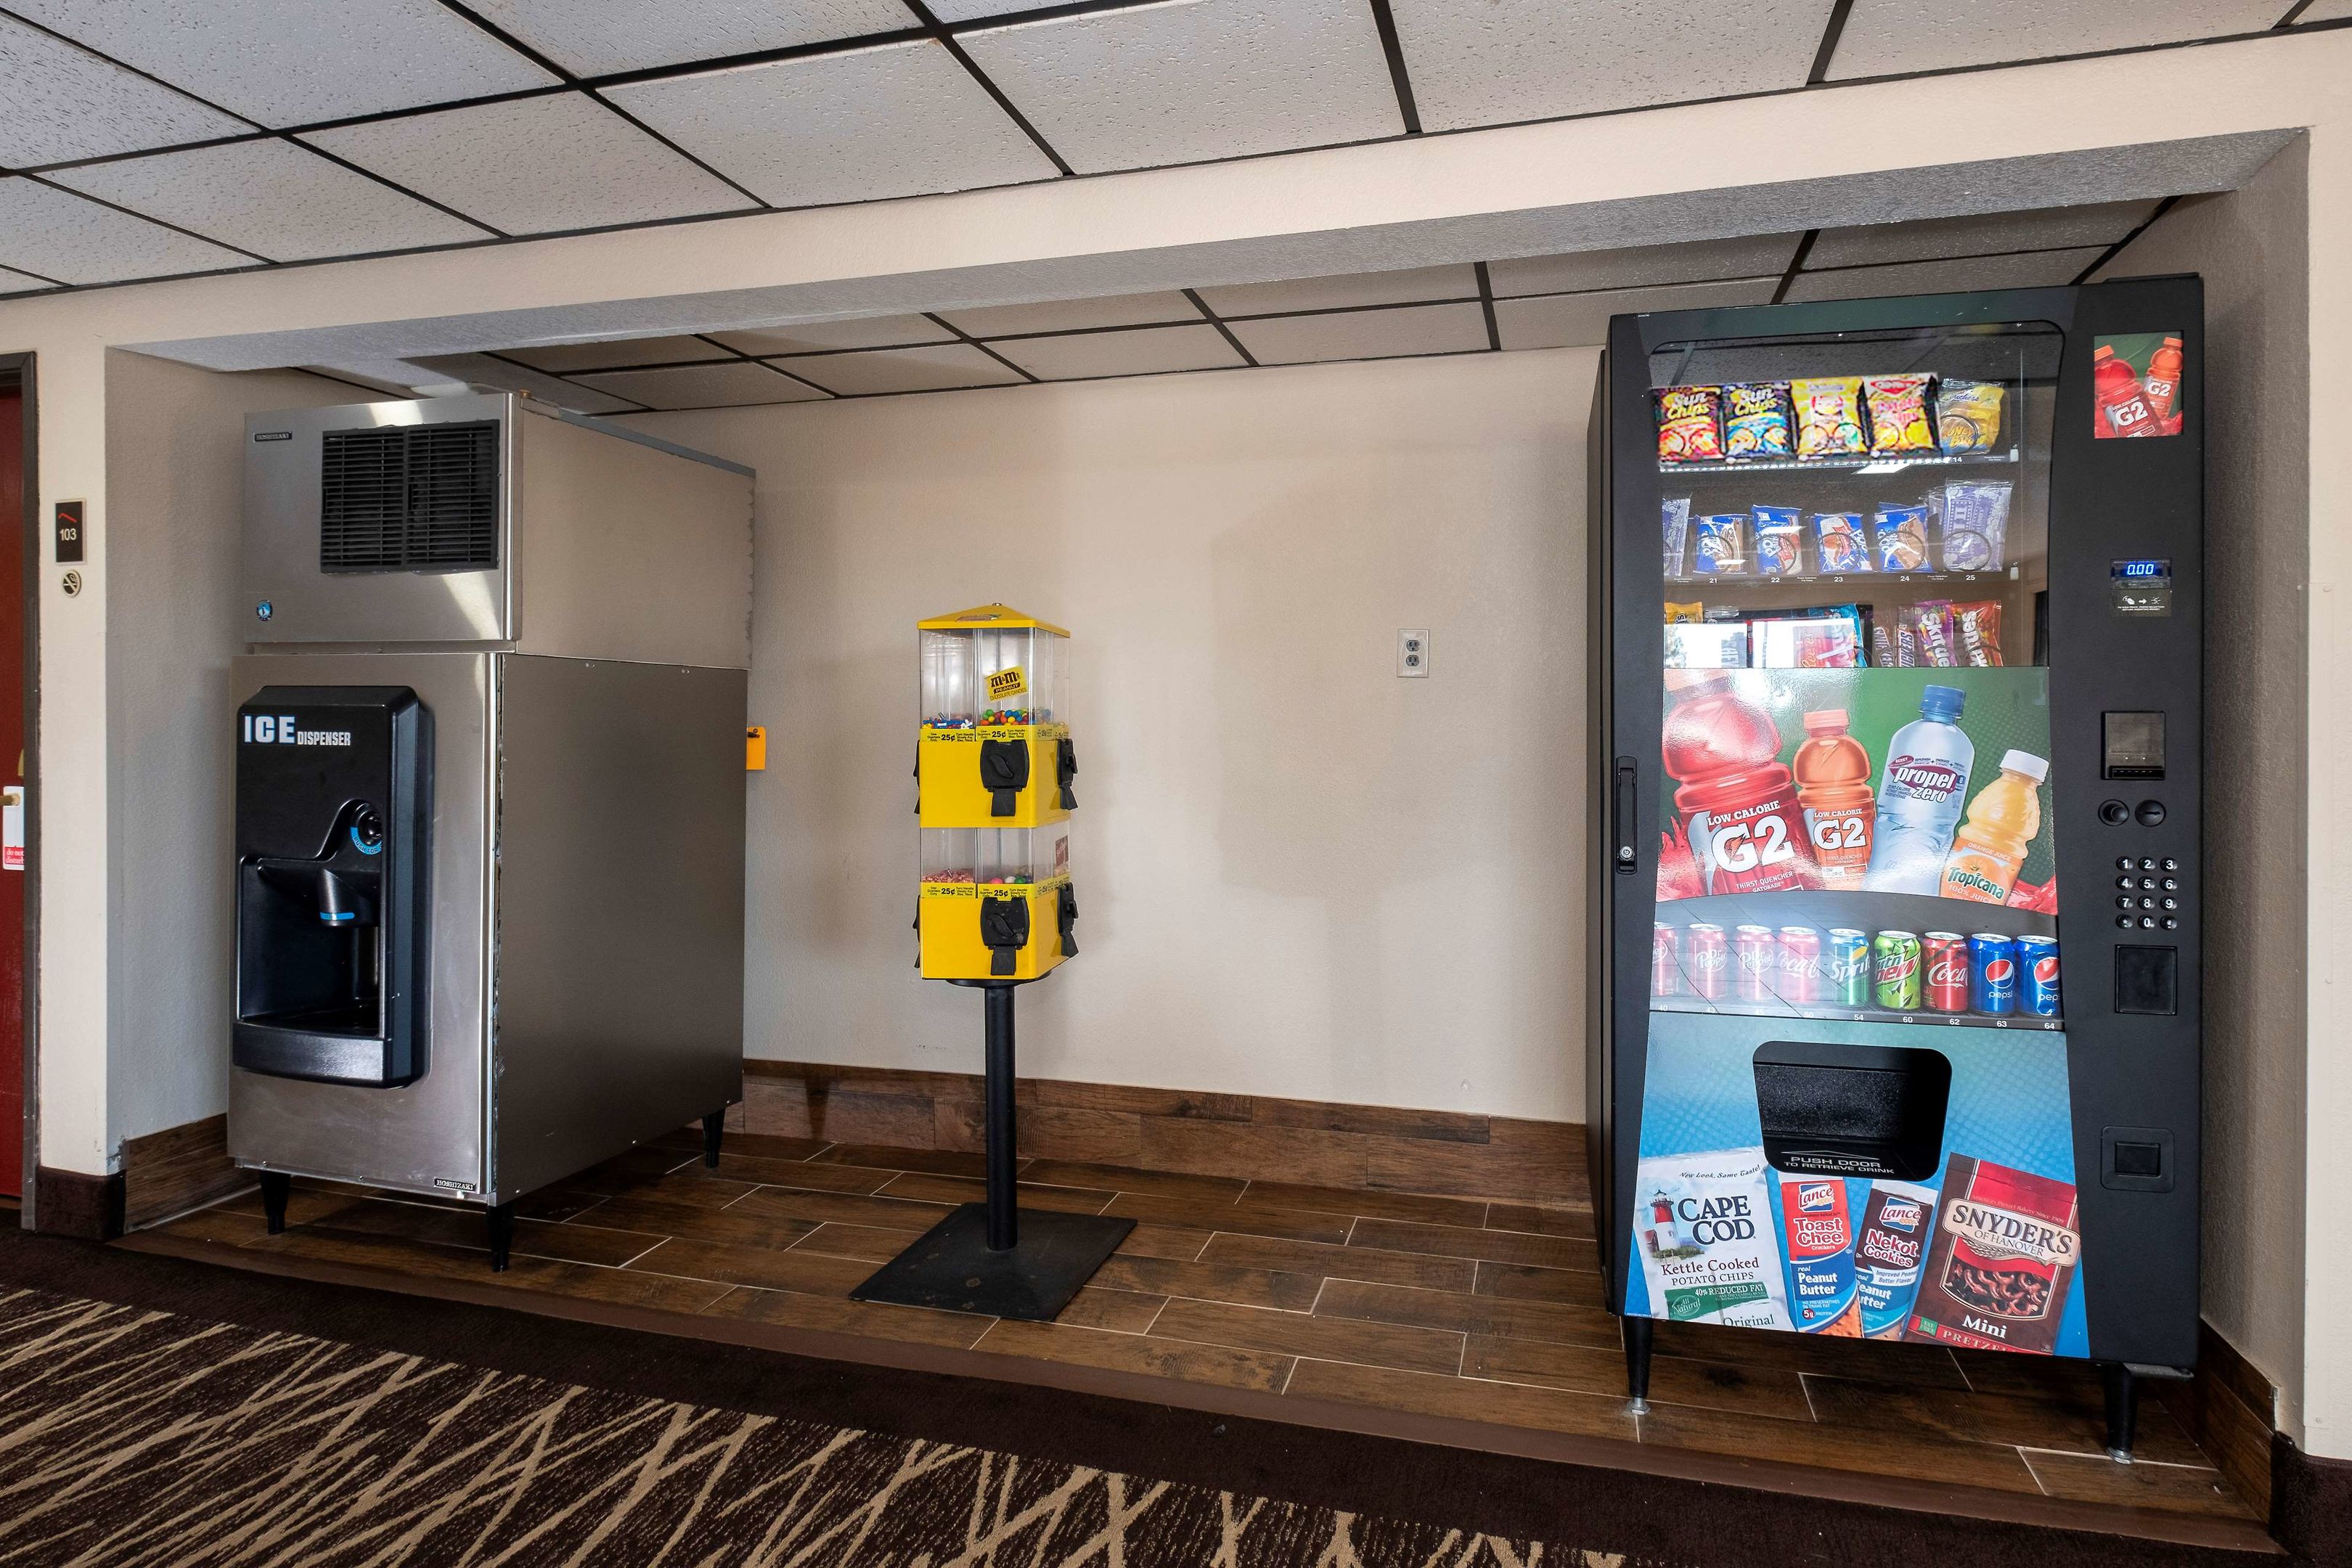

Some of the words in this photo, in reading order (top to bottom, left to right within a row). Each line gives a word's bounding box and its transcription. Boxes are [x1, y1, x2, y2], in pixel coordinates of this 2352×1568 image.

[2149, 382, 2171, 396] G2
[2115, 401, 2148, 426] G2
[60, 528, 77, 541] 103
[995, 684, 1018, 693] PEANUT
[245, 716, 295, 743] ICE
[297, 731, 351, 746] DISPENSER
[1893, 767, 1956, 789] propel
[1911, 786, 1948, 803] zero
[1707, 813, 1731, 826] LOW
[1734, 801, 1781, 820] CALORIE
[1813, 817, 1866, 850] G2
[1712, 814, 1795, 873] G2
[1968, 842, 1994, 854] ORANGE
[1994, 852, 2012, 862] JUICE
[2123, 859, 2128, 869] 1
[2144, 859, 2151, 869] 2
[2166, 859, 2173, 870] 3
[1736, 880, 1757, 889] THIRST
[1760, 871, 1794, 885] QUENCHER
[1948, 867, 2004, 899] Tropicana
[2121, 878, 2128, 888] 4
[2144, 879, 2151, 889] 5
[2165, 880, 2173, 889] 6
[1951, 885, 1969, 896] 100%
[2123, 898, 2129, 907] 7
[2144, 899, 2150, 907] 8
[2165, 899, 2173, 909] 9
[2144, 918, 2150, 928] 0
[1697, 953, 1726, 968] Pepper
[1711, 950, 1723, 959] Dr
[1741, 952, 1772, 969] Pepper
[1752, 950, 1765, 959] Dr
[1830, 954, 1870, 983] Sprit
[1988, 989, 2013, 999] pepsi
[2038, 994, 2059, 1003] pep
[1740, 1164, 1760, 1177] Taste!
[1838, 1159, 1881, 1168] DOOR
[436, 1180, 473, 1191] HOSHIZAKI
[1800, 1188, 1833, 1208] Lance
[1678, 1195, 1751, 1222] CAPE
[1881, 1207, 1922, 1221] Lance
[2017, 1205, 2034, 1215] Bakery
[2035, 1210, 2050, 1220] Since
[1692, 1218, 1755, 1245] COD
[1794, 1217, 1842, 1232] Toast
[1953, 1204, 2073, 1254] SNYDER'S
[1796, 1232, 1843, 1246] Chee
[1866, 1228, 1919, 1257] Nekot
[1974, 1230, 1989, 1240] OF
[1990, 1236, 2043, 1257] HANOVER
[1864, 1245, 1913, 1267] Cookies
[1661, 1262, 1703, 1275] Kettle
[1707, 1257, 1760, 1271] Cooked
[1672, 1274, 1716, 1286] POTATO
[1720, 1272, 1754, 1281] CHIPS
[1798, 1273, 1837, 1283] Peanut
[1695, 1288, 1707, 1297] 40%
[1709, 1285, 1748, 1296] REDUCED
[1750, 1283, 1764, 1292] FAT
[1799, 1284, 1836, 1295] Butter
[1673, 1298, 1701, 1315] Natural
[1723, 1314, 1774, 1328] Original
[1961, 1315, 2007, 1339] Mini
[1943, 1330, 2016, 1352] PRETZE
